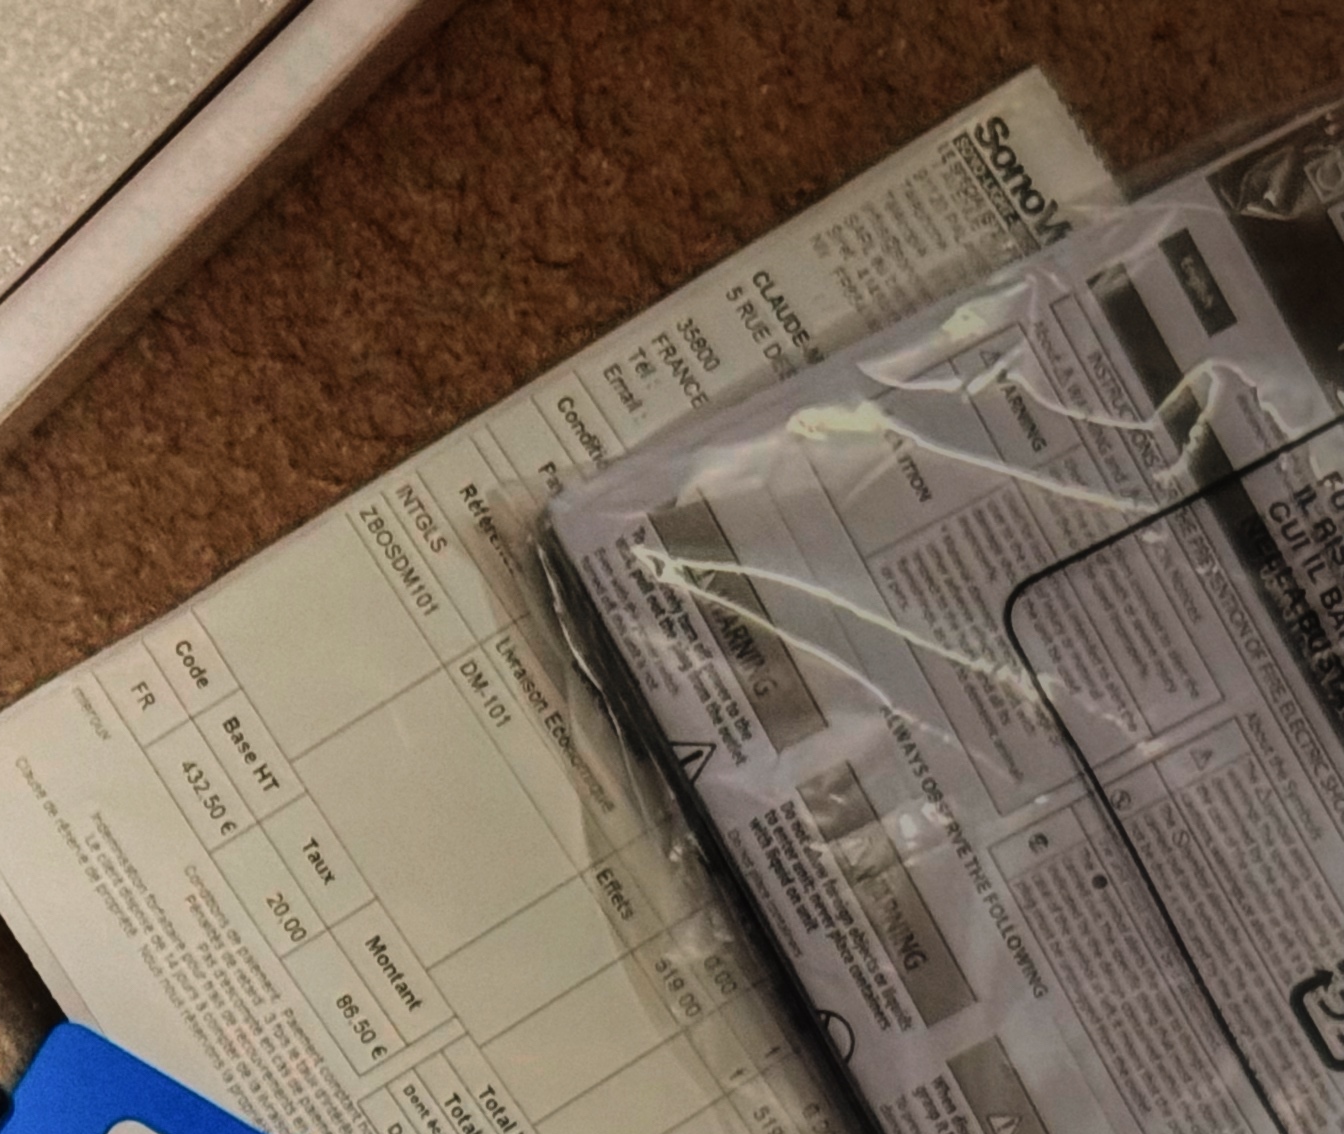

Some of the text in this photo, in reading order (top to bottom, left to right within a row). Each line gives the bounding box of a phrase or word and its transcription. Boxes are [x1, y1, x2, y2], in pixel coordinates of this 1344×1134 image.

[725, 285, 744, 302] 5
[736, 299, 772, 343] RUE
[651, 331, 710, 411] FRANCE
[676, 317, 721, 372] 35800
[602, 363, 643, 413] Email
[395, 482, 449, 554] INTGLS
[174, 639, 209, 689] Code
[130, 679, 157, 711] FR
[358, 504, 440, 616] ZBOSDM101
[458, 658, 512, 727] DM-101
[595, 866, 634, 920] Effets
[221, 714, 280, 792] Base HT
[219, 819, 238, 835] €
[302, 836, 336, 886] Taux
[963, 855, 991, 893] THE
[983, 892, 1049, 998] FOLLOWING
[364, 933, 423, 1012] Montant
[370, 1044, 388, 1060] €
[402, 1083, 430, 1120] Dont
[478, 1083, 518, 1134] Total
